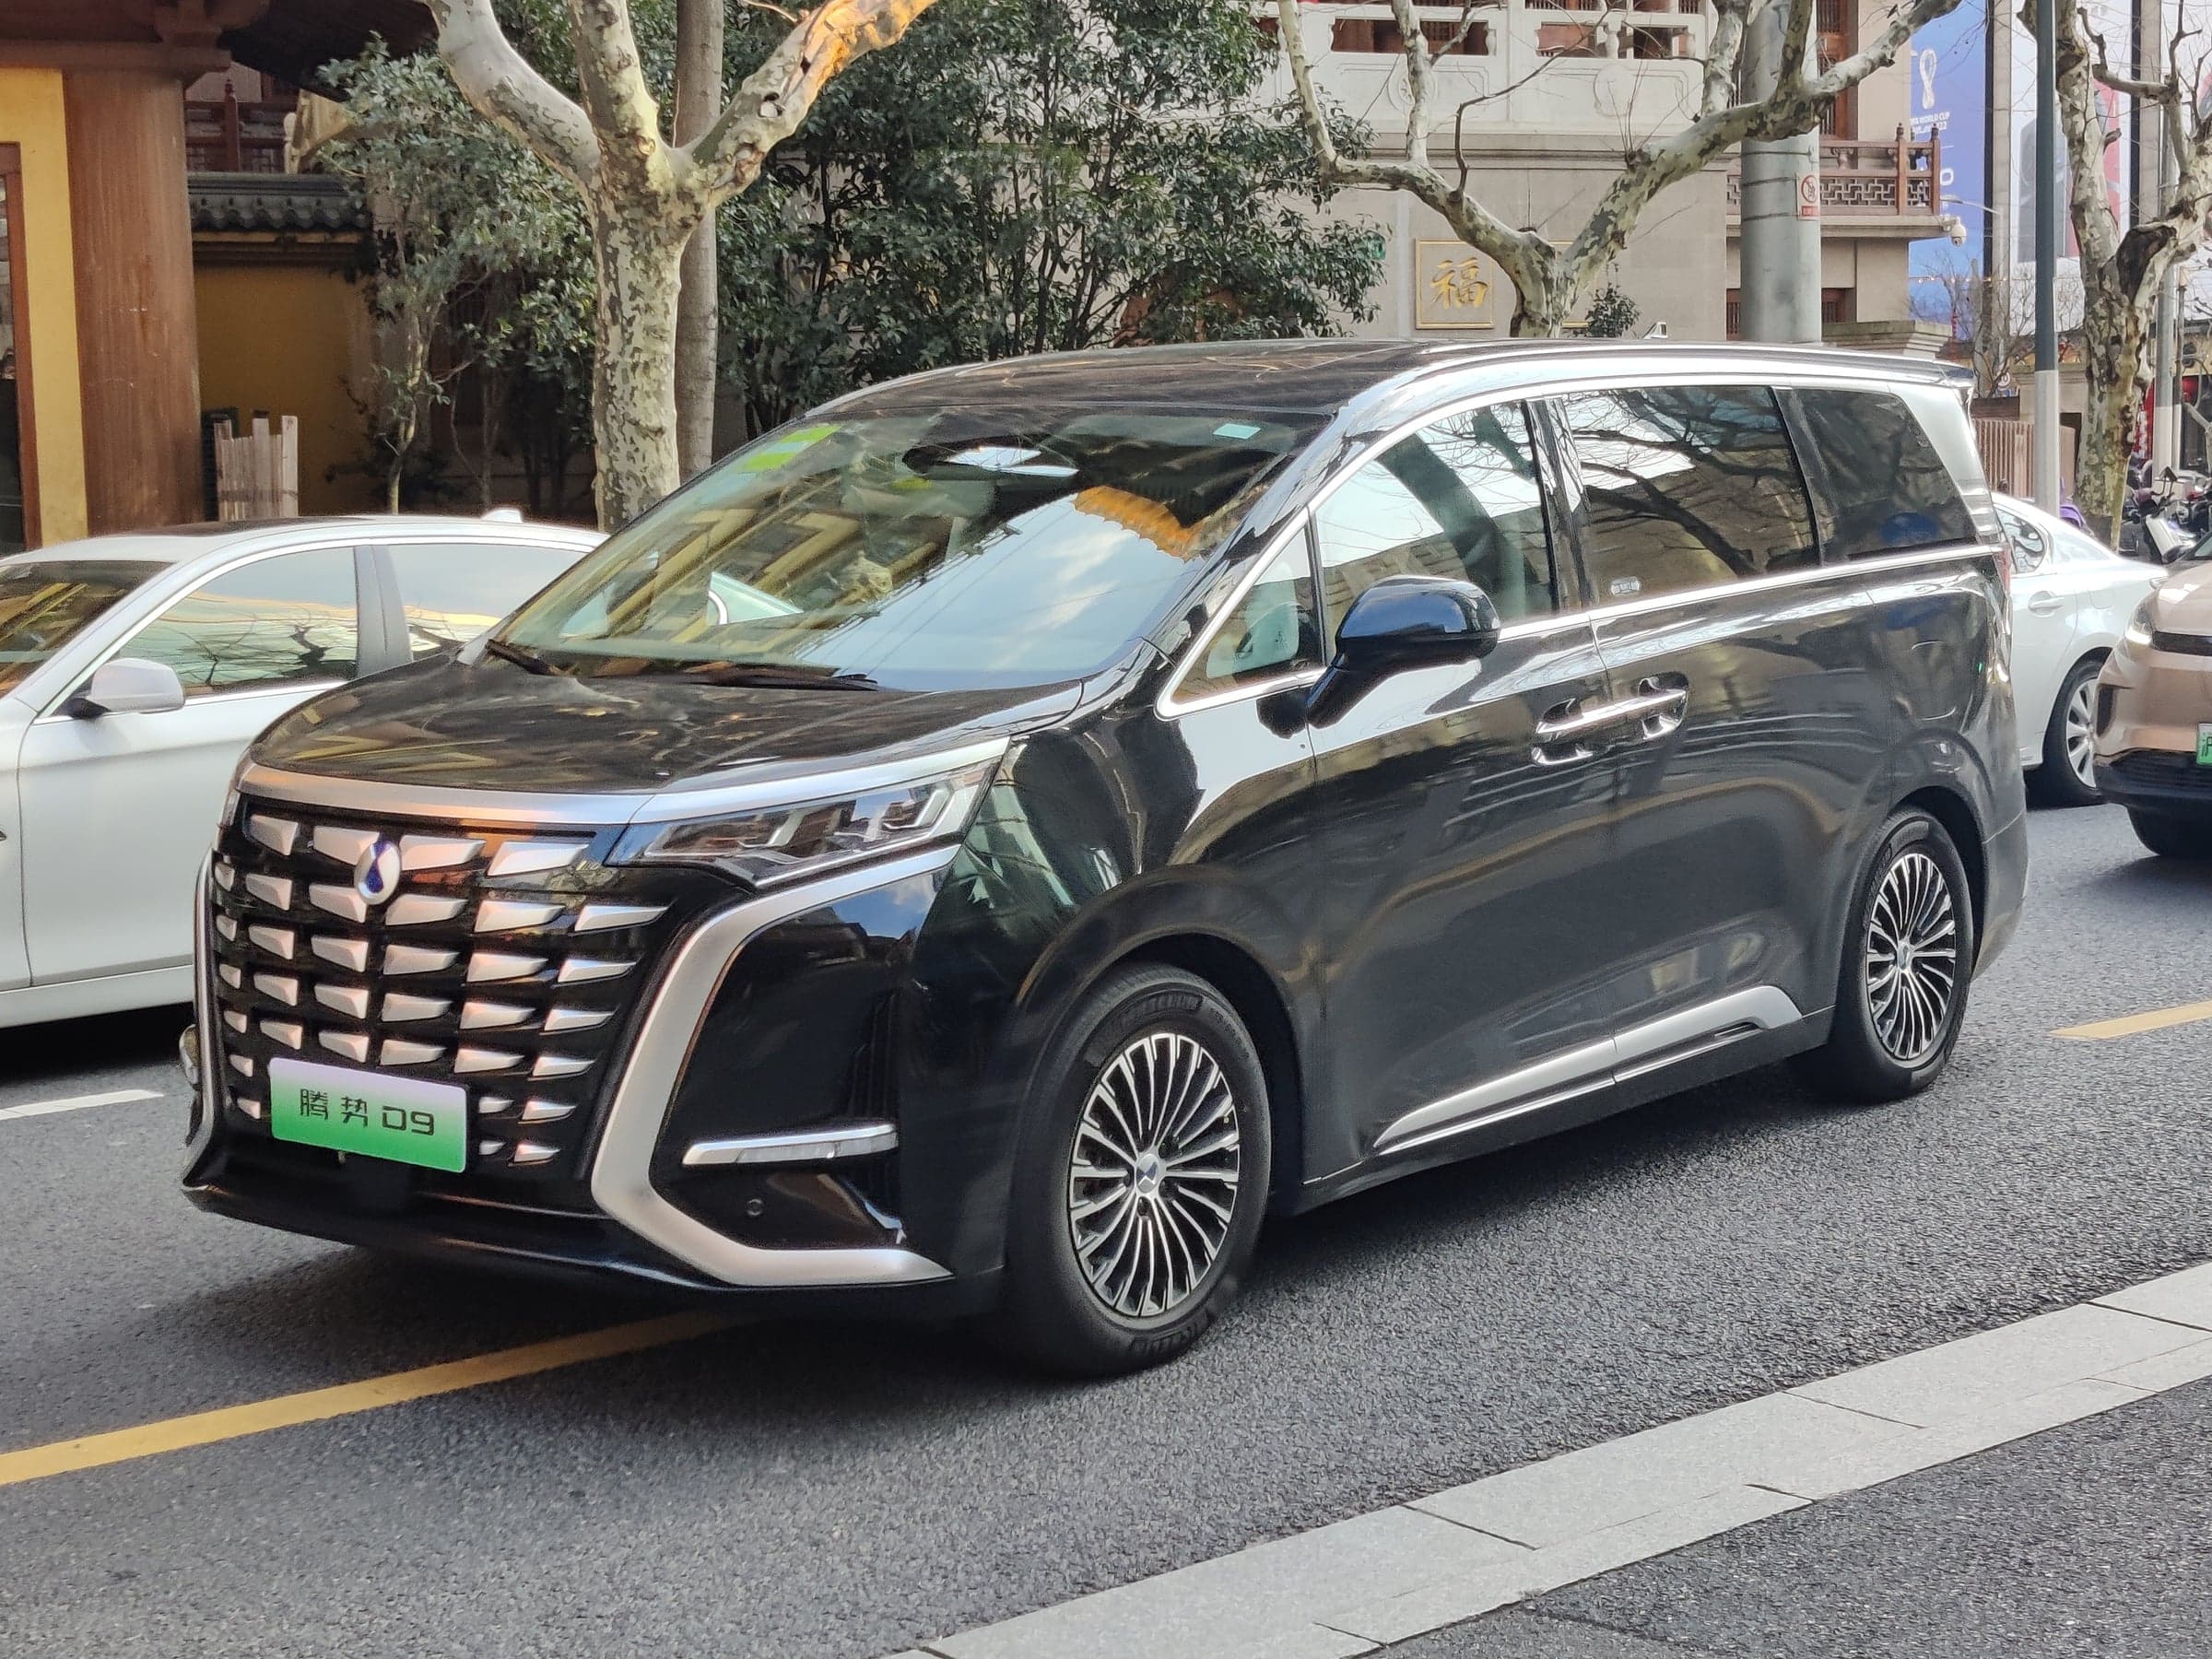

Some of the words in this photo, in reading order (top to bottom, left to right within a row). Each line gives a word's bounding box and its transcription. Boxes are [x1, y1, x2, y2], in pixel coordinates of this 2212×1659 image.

[1430, 256, 1488, 310] 福
[300, 1088, 369, 1128] 腾势
[382, 1105, 435, 1136] D9
